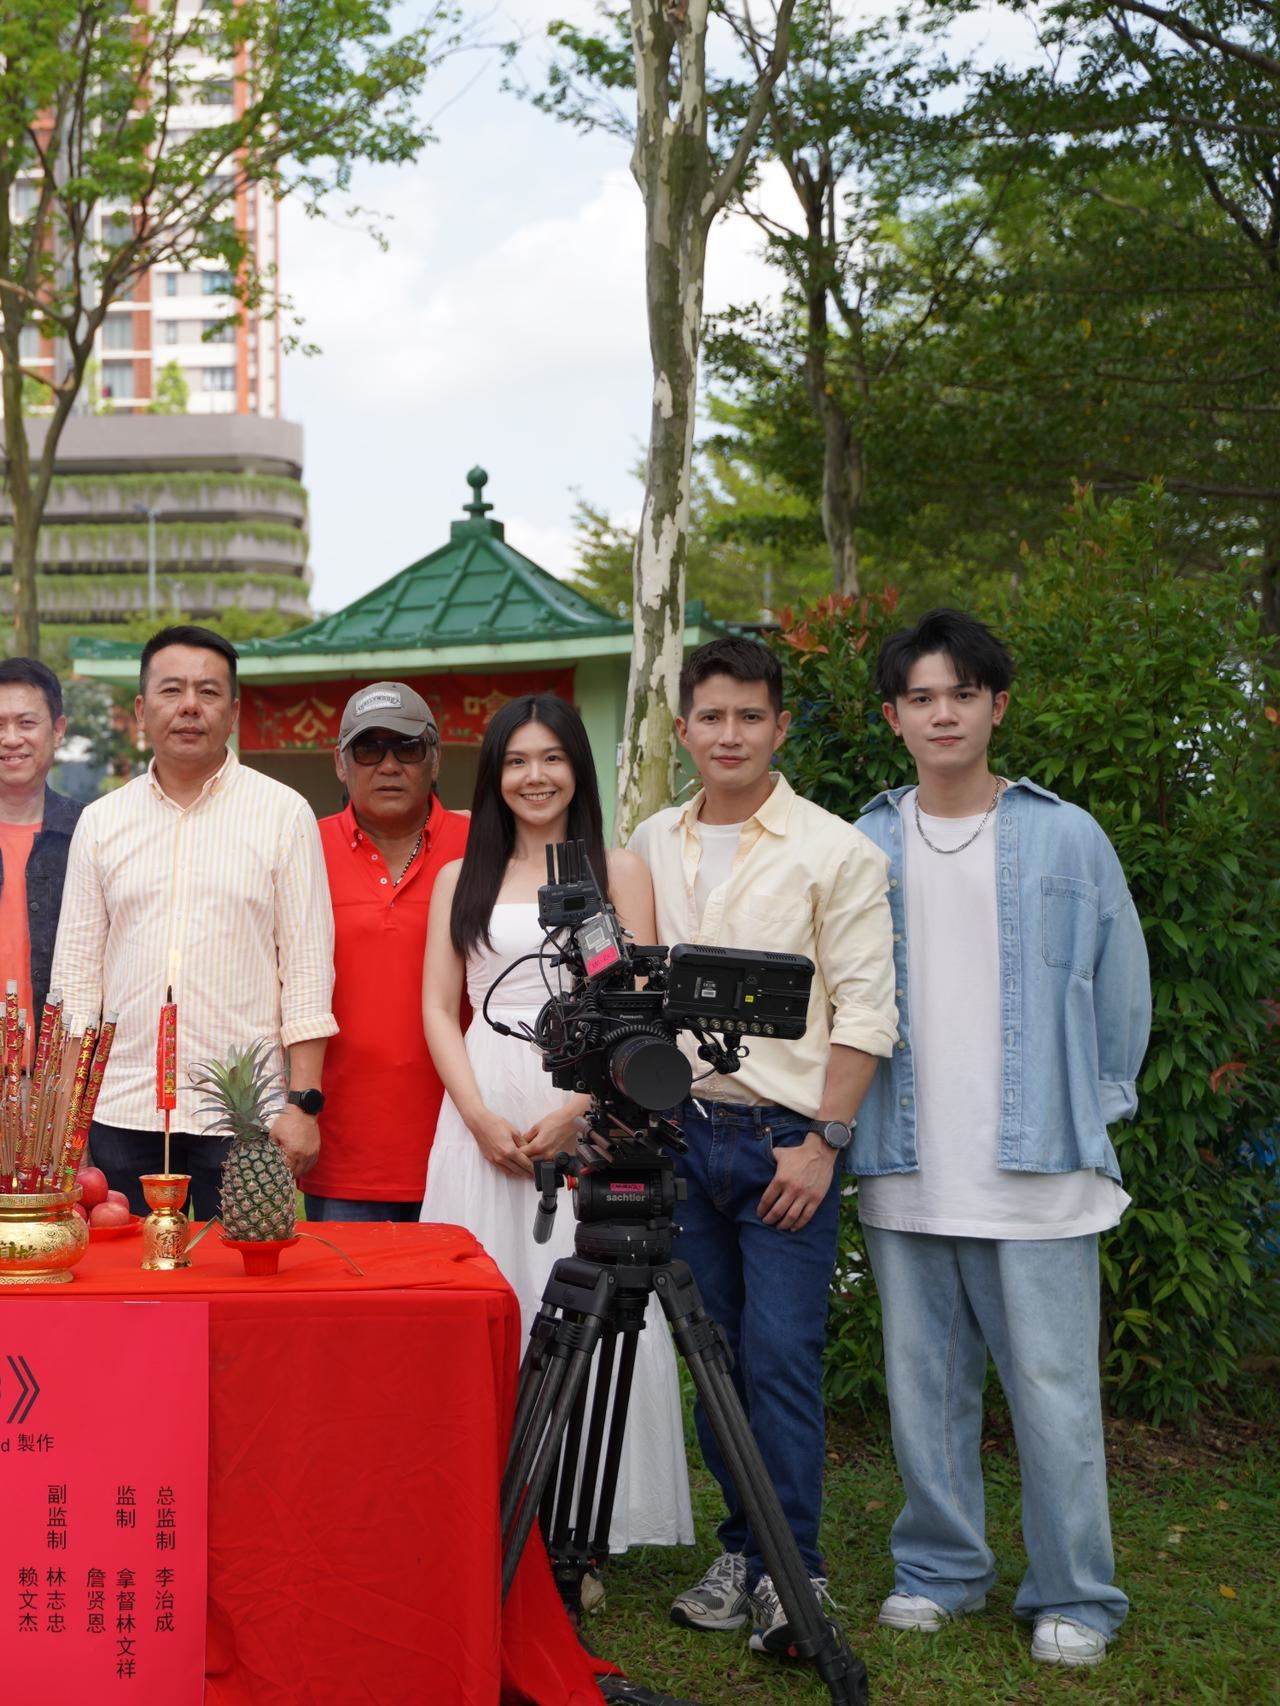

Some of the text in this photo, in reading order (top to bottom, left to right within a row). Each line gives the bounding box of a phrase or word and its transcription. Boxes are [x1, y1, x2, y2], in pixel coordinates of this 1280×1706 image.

[18, 1434, 53, 1452] 製作
[47, 1484, 67, 1550] 副监制
[116, 1486, 136, 1528] 监制
[156, 1486, 176, 1550] 总监制
[19, 1567, 38, 1632] 赖文杰
[47, 1567, 66, 1632] 林志忠
[87, 1568, 106, 1633] 詹贤恩
[117, 1568, 136, 1679] 拿督林文祥
[155, 1568, 174, 1632] 李治成
